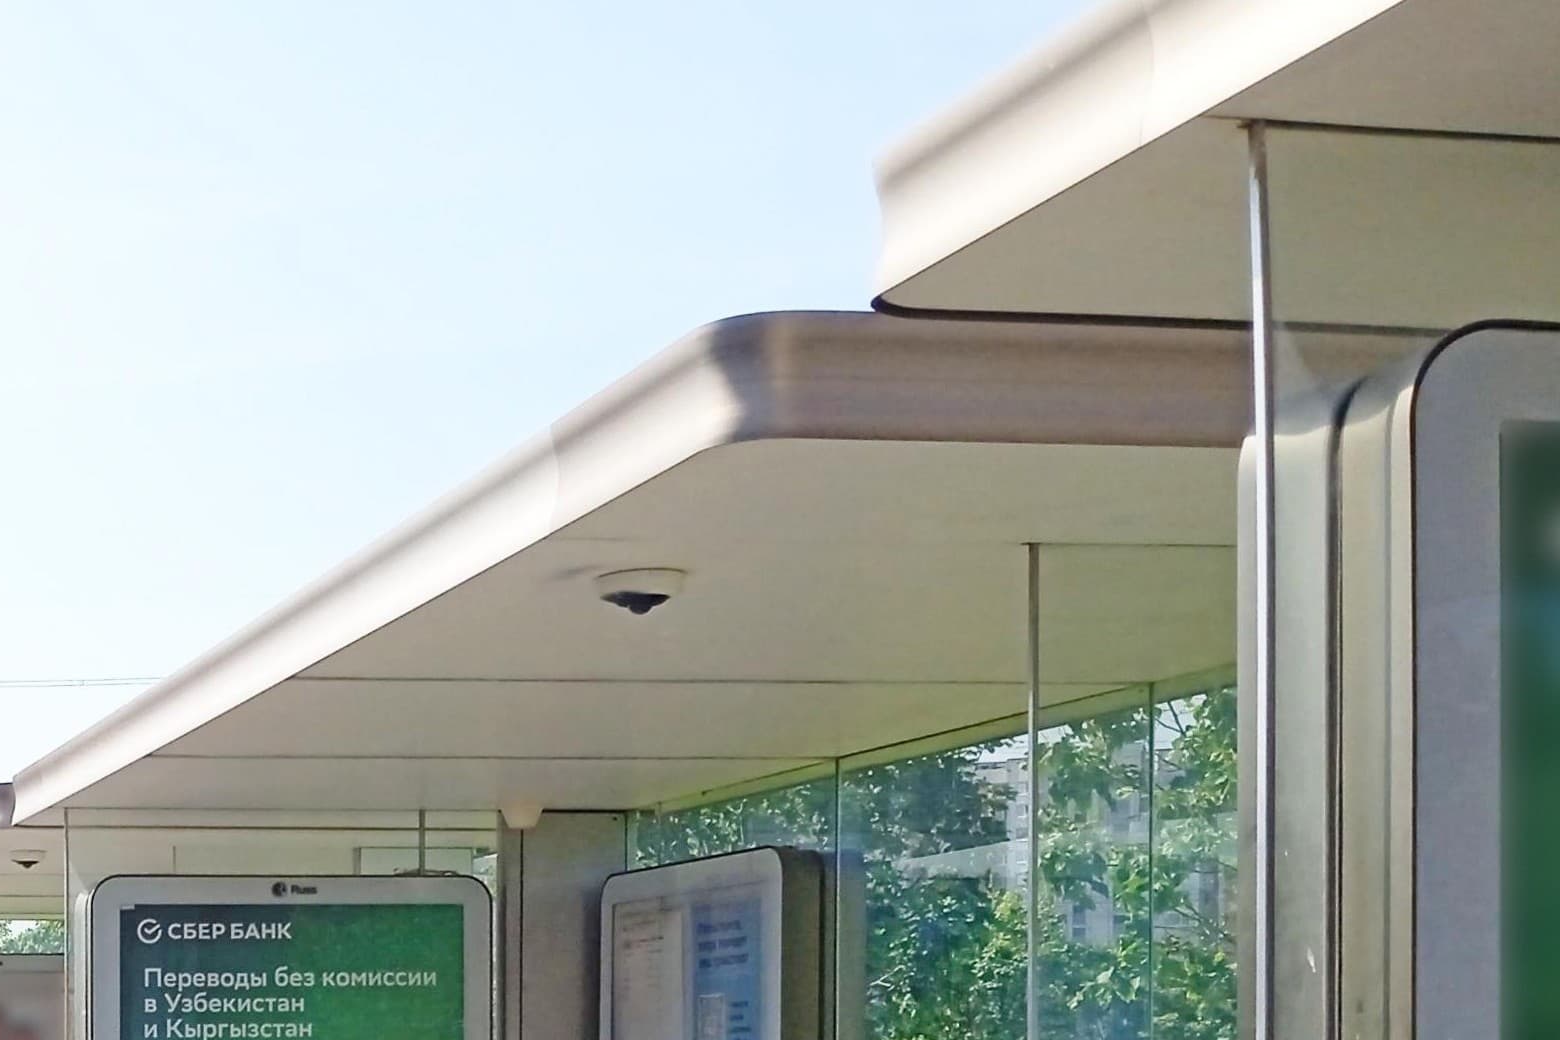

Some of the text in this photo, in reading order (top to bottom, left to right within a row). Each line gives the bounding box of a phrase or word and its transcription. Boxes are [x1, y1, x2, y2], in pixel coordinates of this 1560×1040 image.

[144, 967, 437, 991] Переводы без комиссии
[144, 993, 304, 1014] в Узбекистан
[144, 1023, 158, 1038] и
